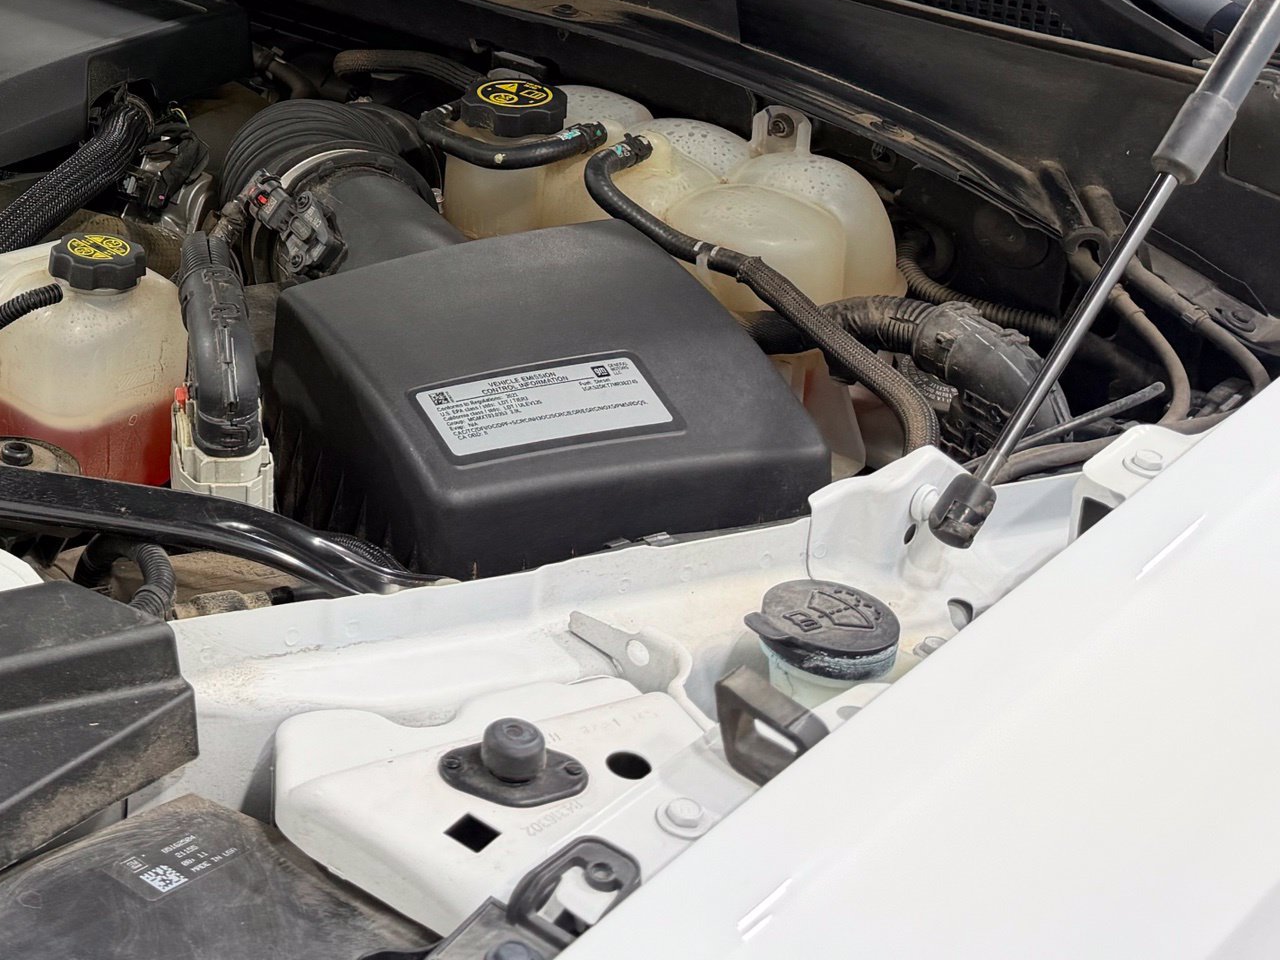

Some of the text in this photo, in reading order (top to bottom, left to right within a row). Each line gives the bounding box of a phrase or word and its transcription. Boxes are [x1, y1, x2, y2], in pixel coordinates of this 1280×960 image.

[481, 376, 569, 394] CONTROL INFORMATION
[488, 372, 556, 387] VEHICLE EMISSION
[442, 413, 470, 421] California
[190, 861, 211, 873] MADE
[221, 847, 238, 856] USA
